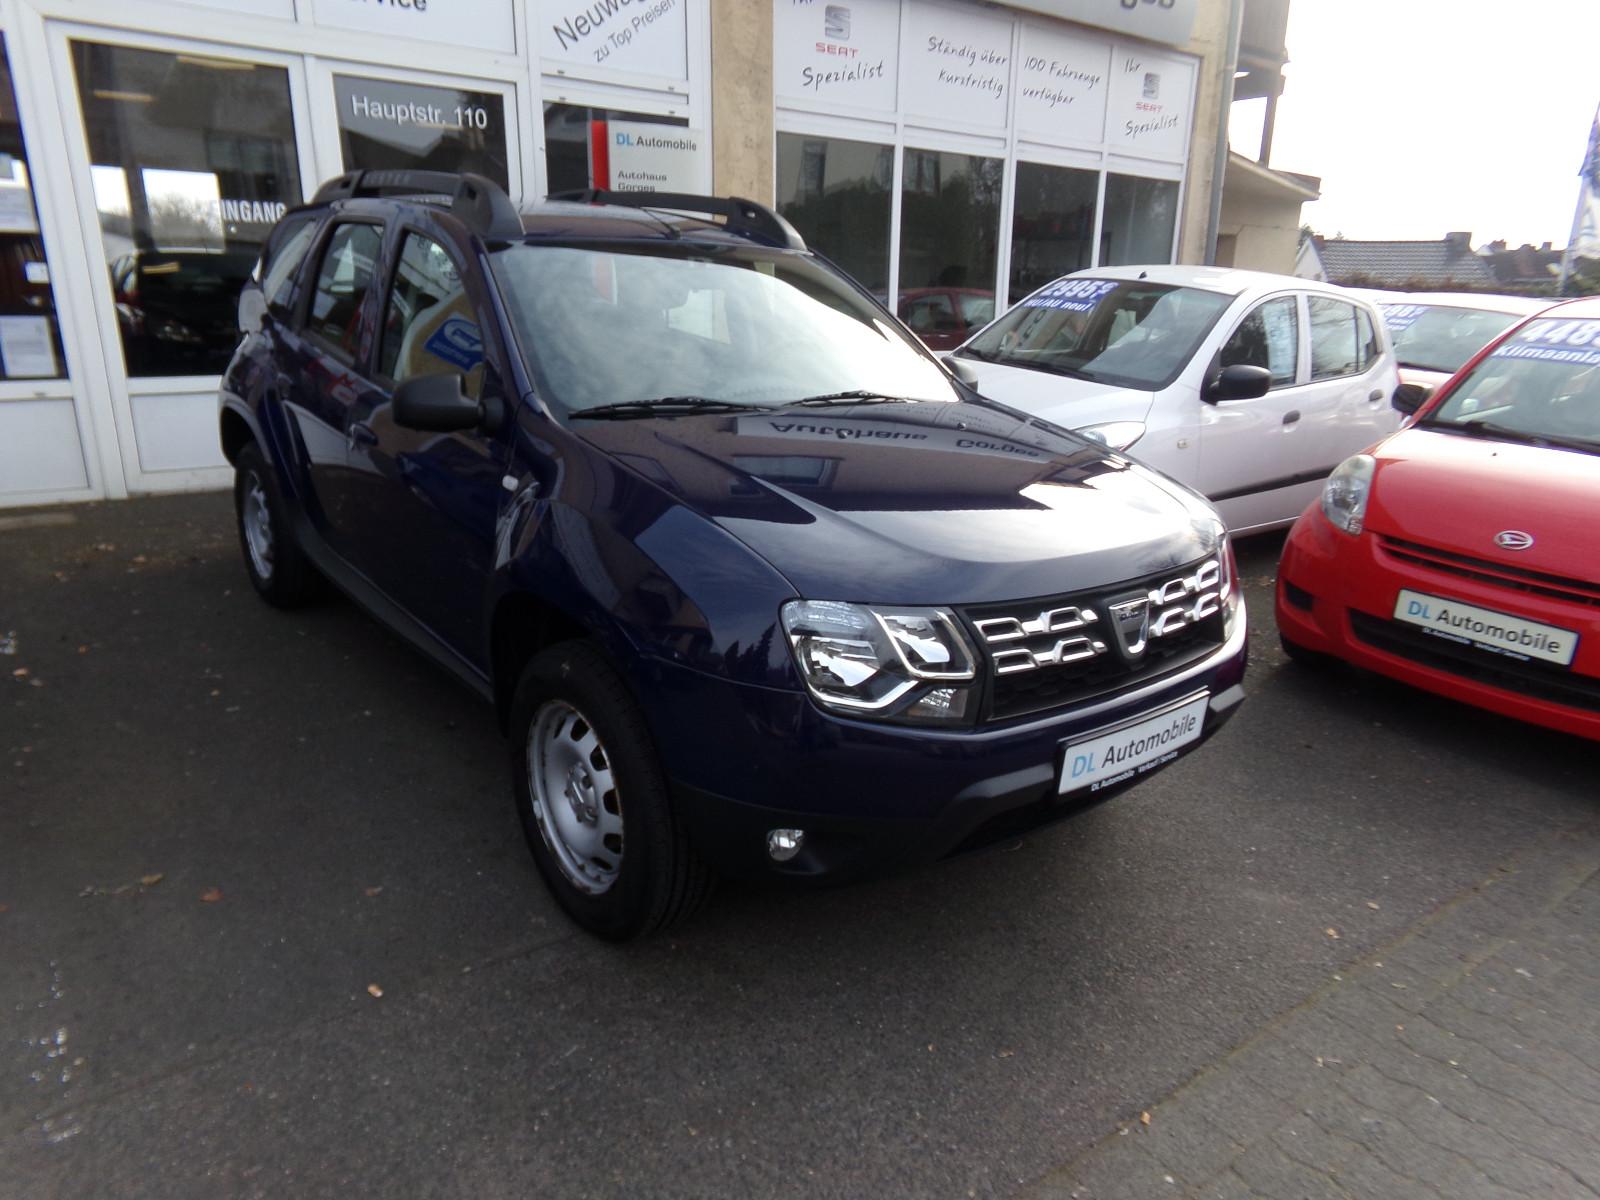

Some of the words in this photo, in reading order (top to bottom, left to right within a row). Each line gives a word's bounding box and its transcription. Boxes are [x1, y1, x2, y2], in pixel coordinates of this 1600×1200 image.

[607, 27, 633, 49] Top
[815, 42, 859, 58] SEAT
[927, 36, 978, 67] Ständig
[981, 52, 1009, 66] über
[802, 60, 884, 92] Spezialist
[1024, 55, 1047, 73] 100
[1050, 61, 1102, 90] Fahrzeuge
[1125, 58, 1142, 73] Ihr
[351, 94, 447, 126] Hauptstr.
[454, 106, 488, 130] 110
[1135, 101, 1163, 113] SEAT
[1126, 115, 1179, 139] Spezialist
[616, 132, 634, 147] DL
[636, 136, 697, 151] Automobile
[617, 170, 668, 182] Autohaus
[1407, 600, 1431, 620] DL
[1436, 609, 1561, 654] Automobile
[1071, 752, 1096, 779] DL
[1101, 713, 1197, 769] Automobile
